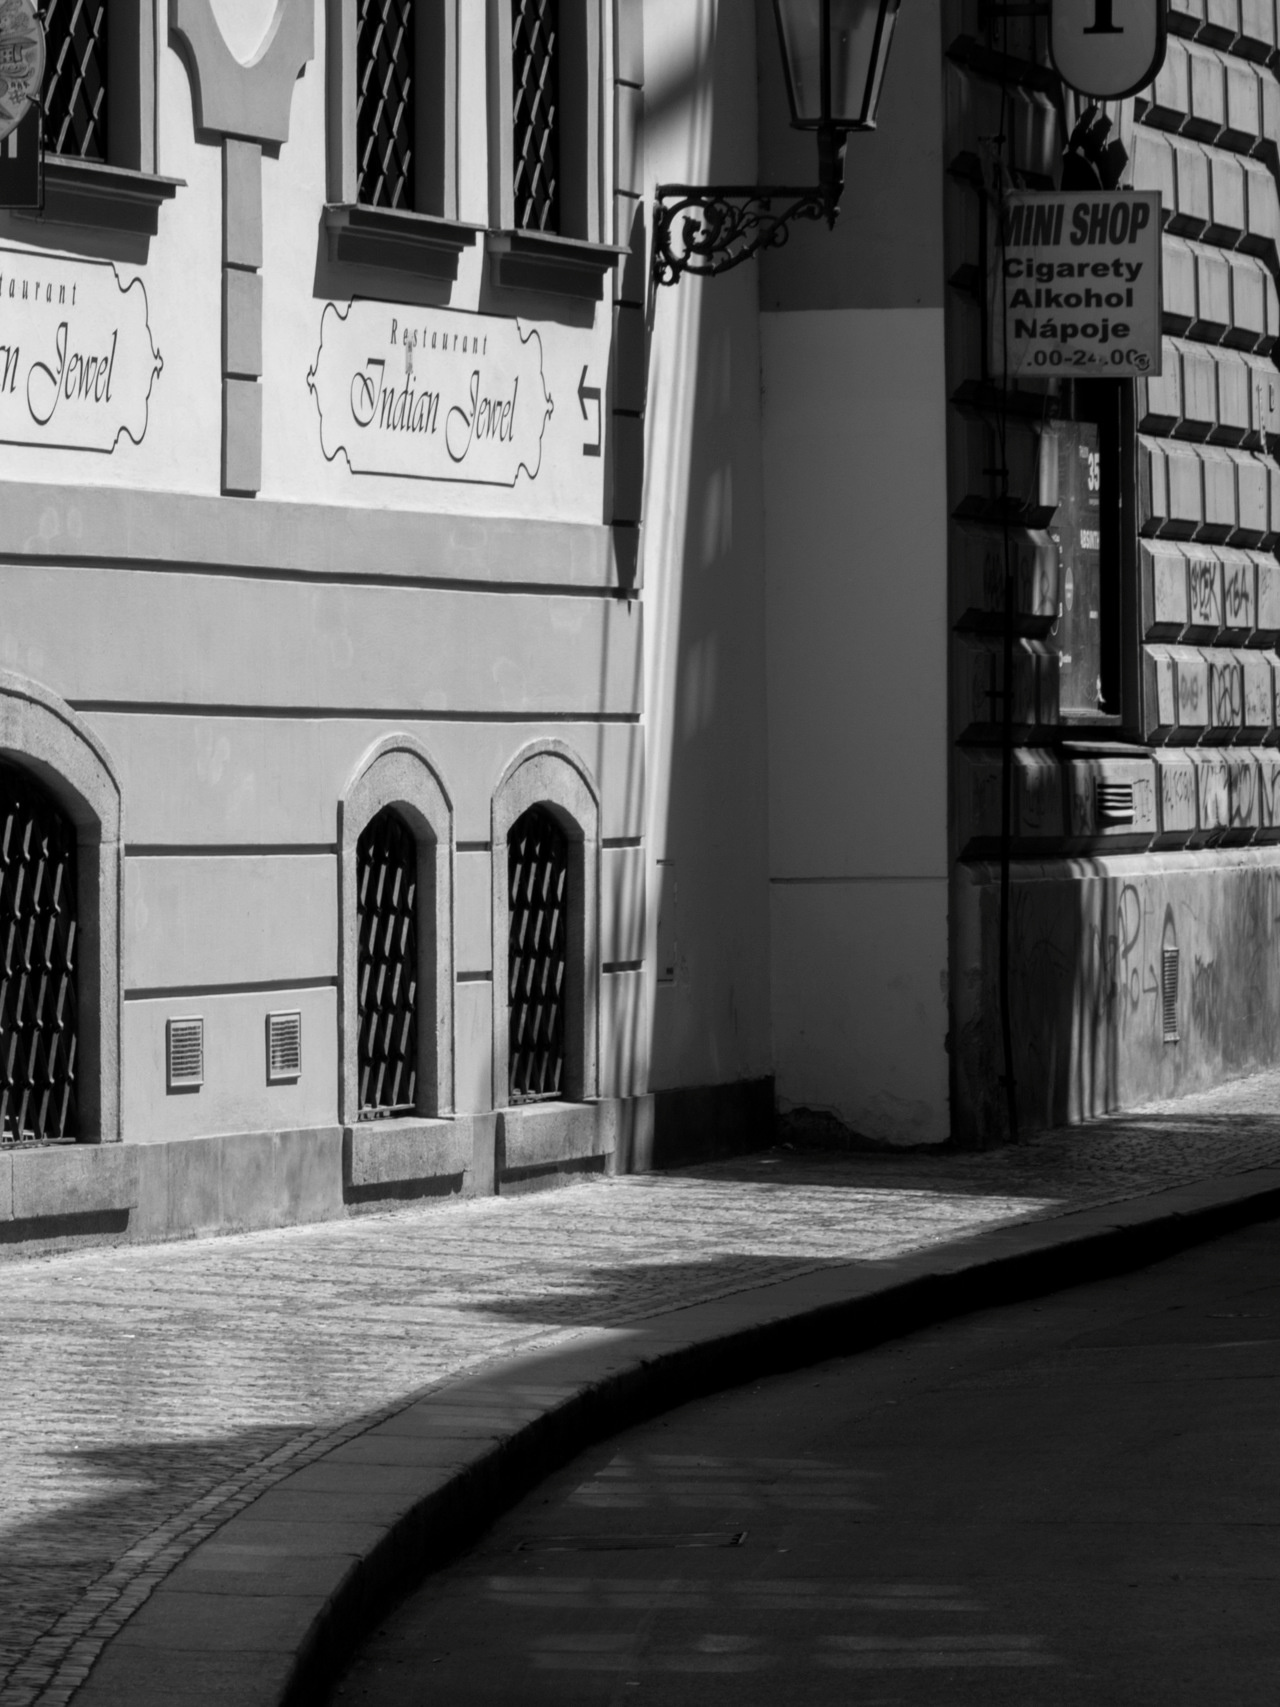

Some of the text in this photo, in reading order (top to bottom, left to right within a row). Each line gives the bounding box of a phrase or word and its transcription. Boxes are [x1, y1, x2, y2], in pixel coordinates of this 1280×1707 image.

[996, 202, 1151, 247] MINI SHOP
[1004, 257, 1143, 283] Cigarety
[1009, 287, 1134, 309] Alkohol
[390, 318, 489, 356] Restaurant
[1014, 317, 1131, 344] Nápoje
[26, 321, 119, 427] Jewel
[349, 357, 520, 463] Indian Jewel
